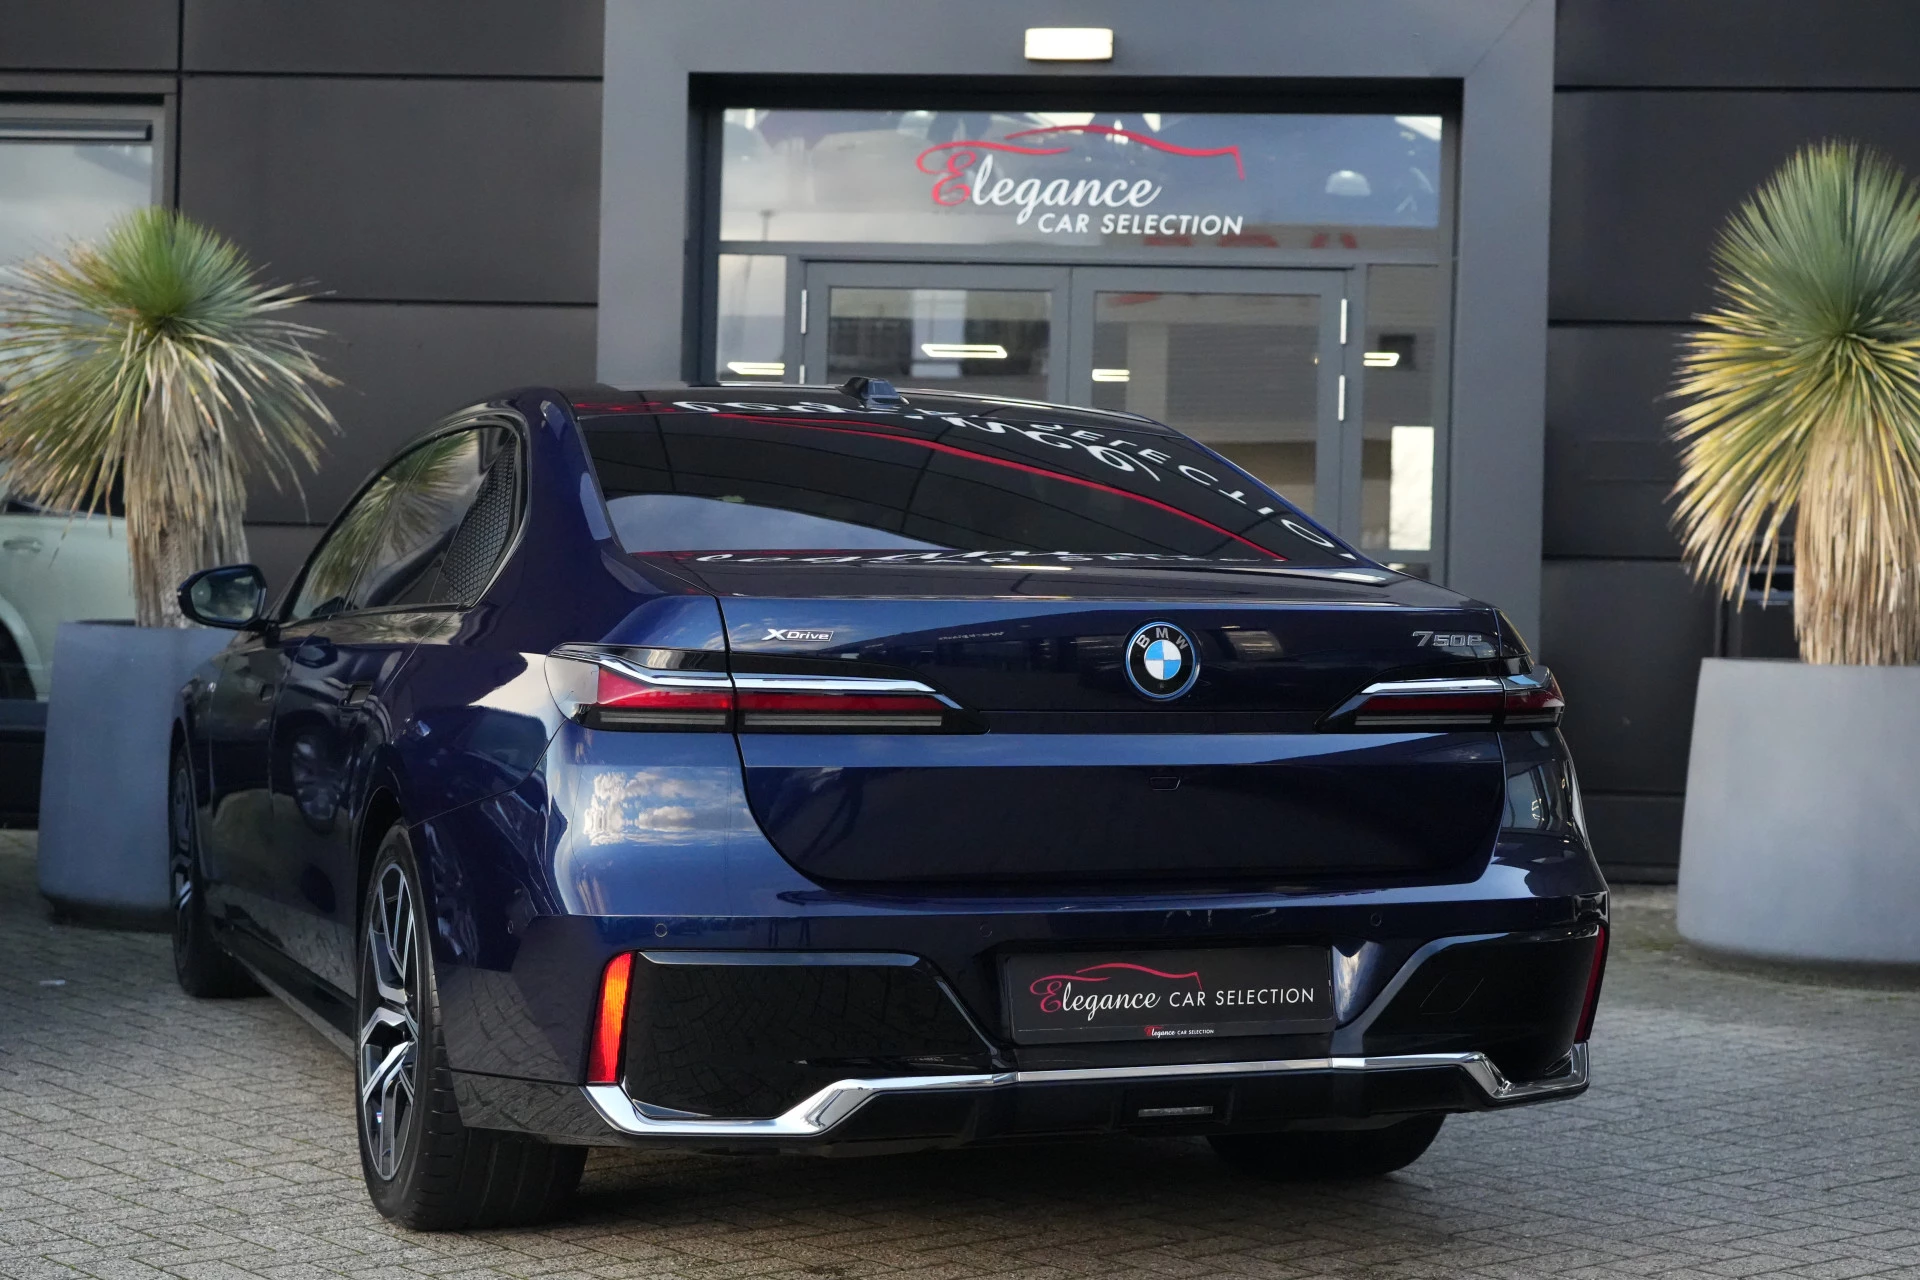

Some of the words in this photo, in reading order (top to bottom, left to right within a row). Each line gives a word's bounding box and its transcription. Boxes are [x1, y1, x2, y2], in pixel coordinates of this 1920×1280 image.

[916, 143, 1162, 225] Elegance
[1038, 213, 1088, 233] CAR
[1101, 214, 1243, 235] SELECTION
[1136, 627, 1188, 649] BMW
[1030, 976, 1160, 1021] Elegance
[1169, 991, 1205, 1007] CAR
[1215, 988, 1314, 1005] SELECTION
